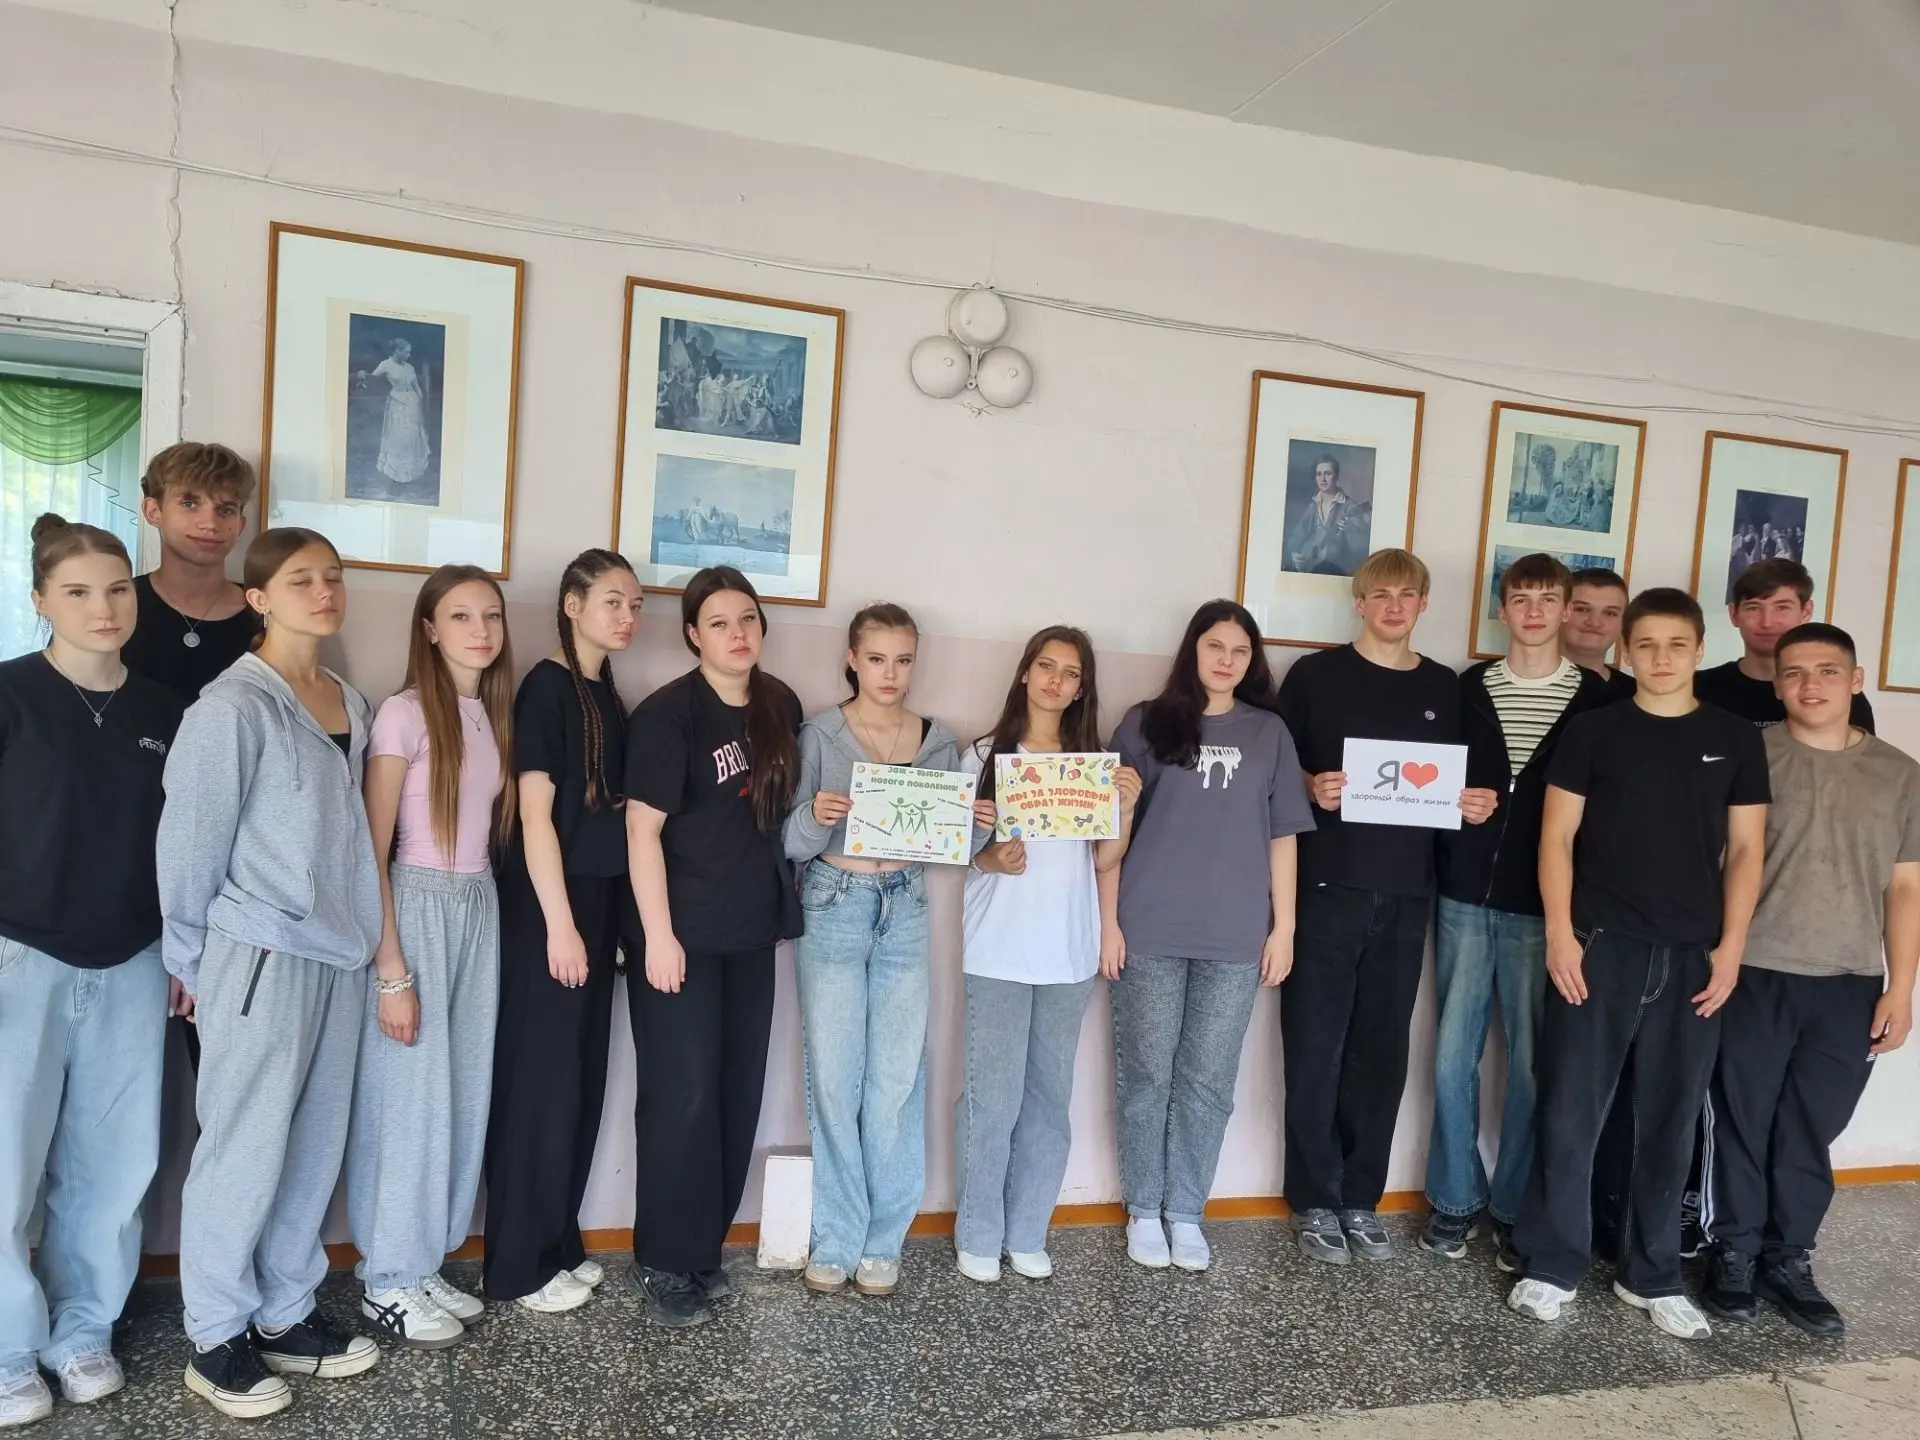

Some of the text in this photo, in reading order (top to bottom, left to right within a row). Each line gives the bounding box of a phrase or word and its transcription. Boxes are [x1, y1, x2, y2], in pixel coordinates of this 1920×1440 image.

[888, 766, 907, 774] ЗОЖ
[917, 769, 945, 778] ВЫБОР
[1373, 760, 1401, 792] Я
[871, 776, 905, 787] НОВОГО
[1006, 787, 1111, 804] МЫ ЗА ЗДОРОВЫЙ
[1351, 793, 1451, 806] здоровый образ жизни
[1020, 798, 1054, 811] ОБРАЗ
